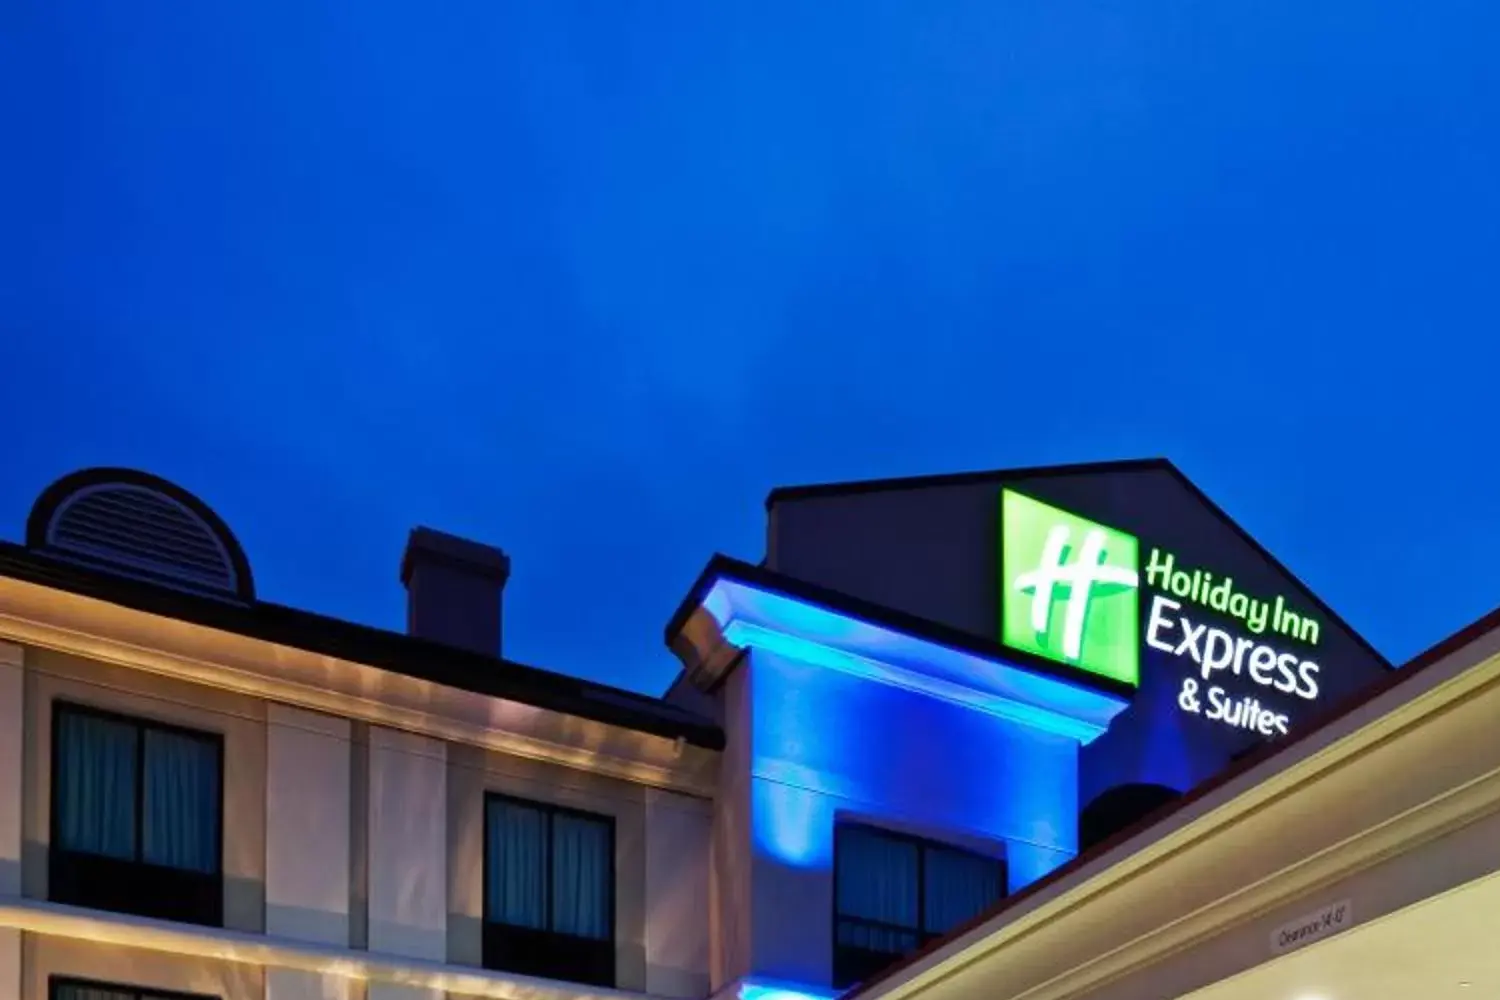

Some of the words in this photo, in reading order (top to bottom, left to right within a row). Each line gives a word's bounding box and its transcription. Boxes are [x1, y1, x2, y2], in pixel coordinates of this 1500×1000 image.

[1145, 548, 1269, 634] Holiday
[1272, 594, 1319, 645] Inn
[1146, 594, 1320, 700] Express
[1178, 677, 1201, 713] &
[1205, 686, 1289, 736] Suites
